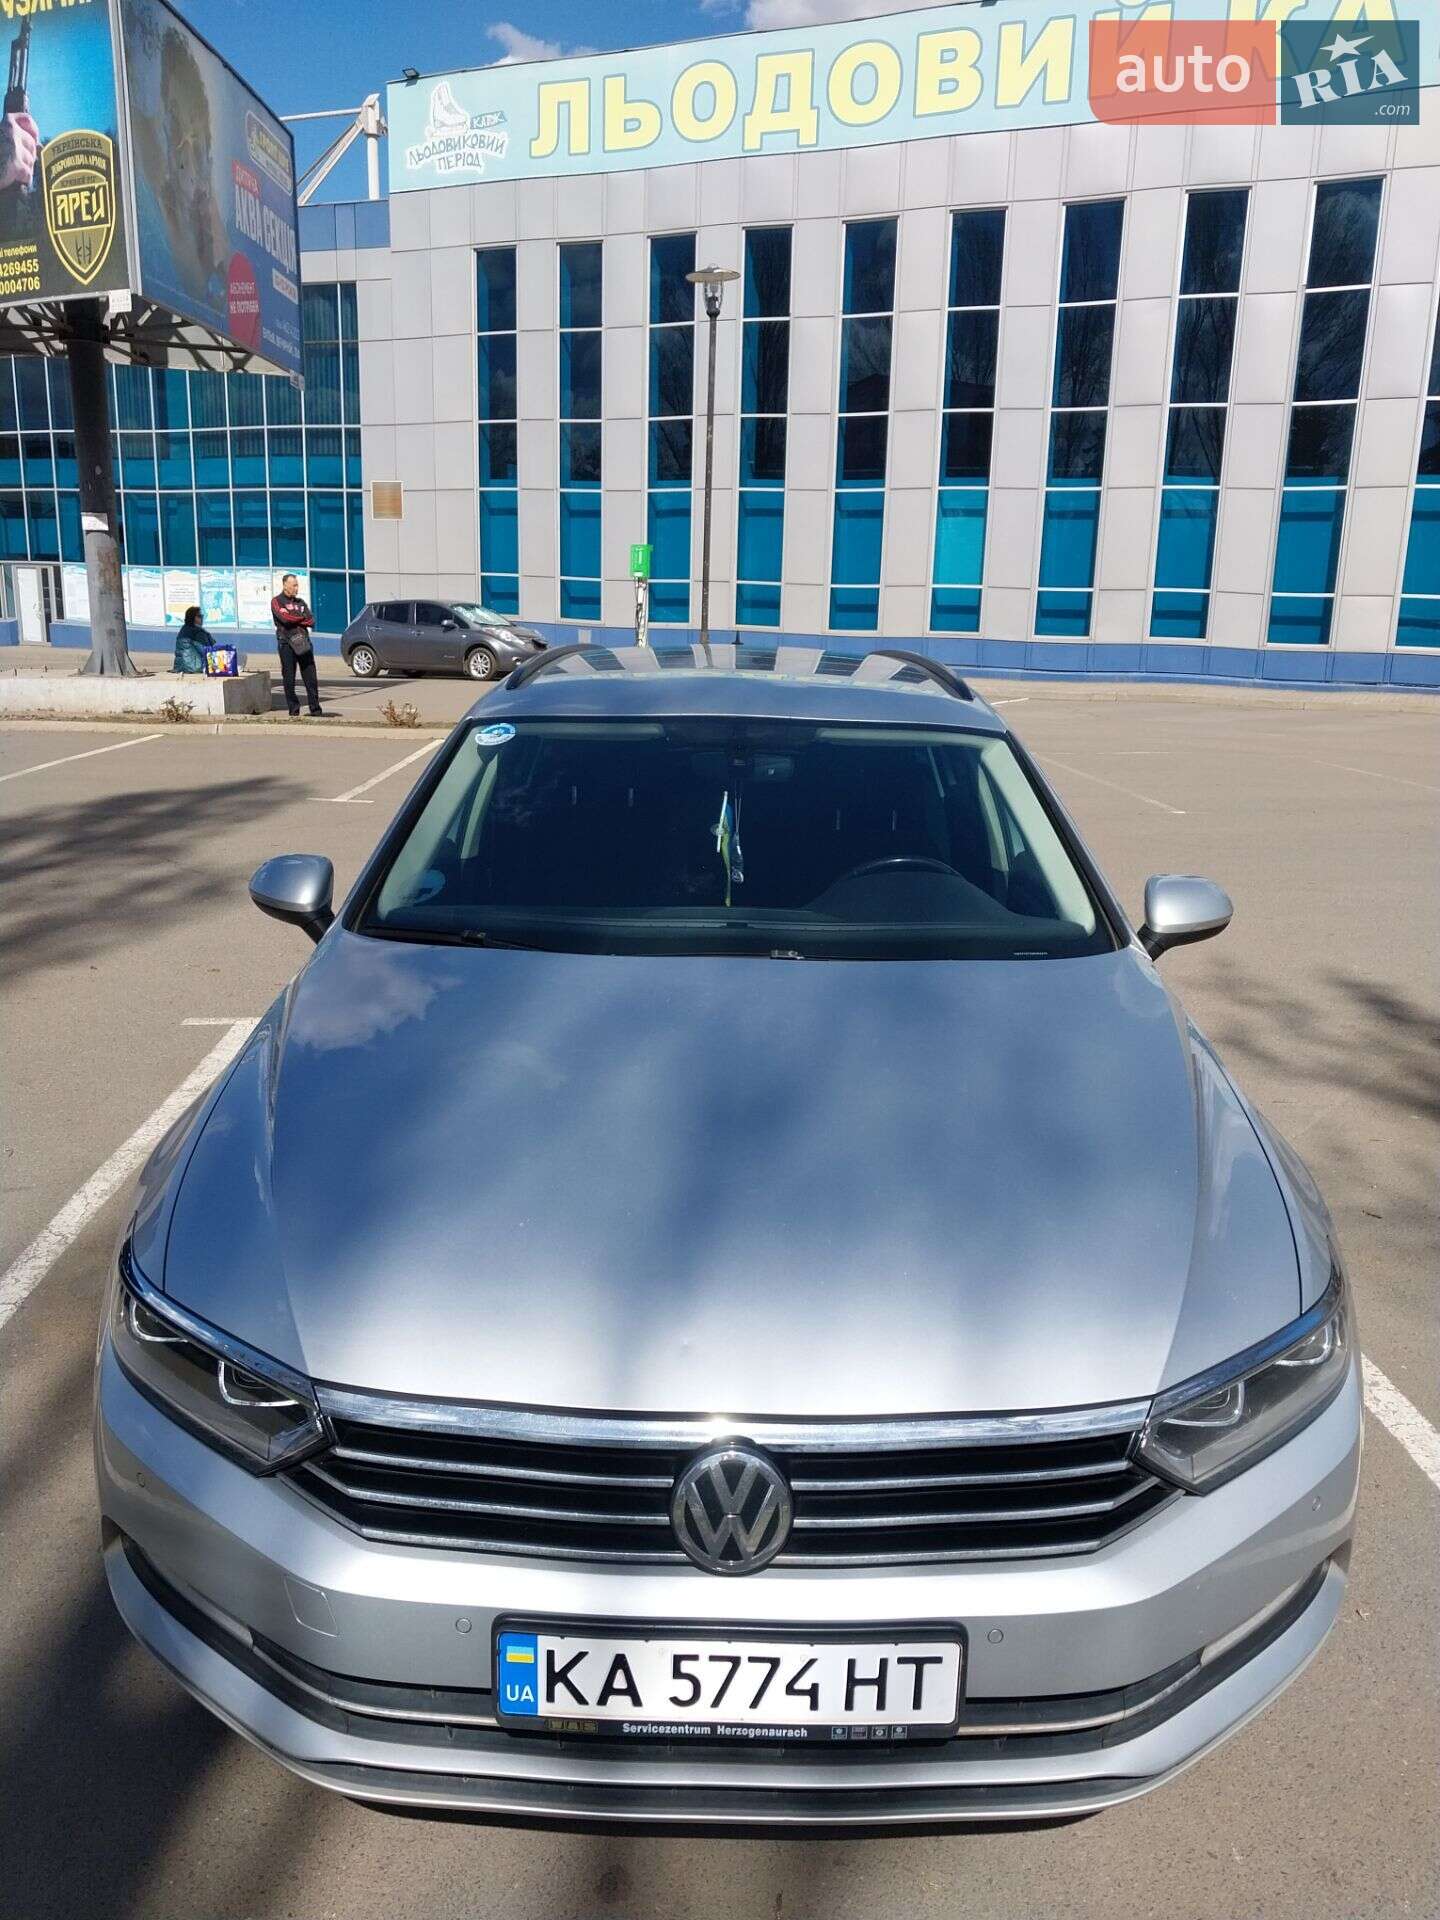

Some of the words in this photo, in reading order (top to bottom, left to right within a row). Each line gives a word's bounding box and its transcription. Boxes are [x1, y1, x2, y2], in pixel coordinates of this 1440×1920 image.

[529, 0, 1174, 159] ЛЬОДОВИЙ
[437, 152, 482, 170] ПЕРІОД
[235, 184, 263, 248] АКВА
[506, 1683, 535, 1702] UA
[546, 1649, 643, 1707] KA
[668, 1653, 819, 1711] 5774
[844, 1656, 943, 1711] HT
[622, 1722, 711, 1735] Servicezentrum
[716, 1725, 808, 1738] Herzogenaurach
